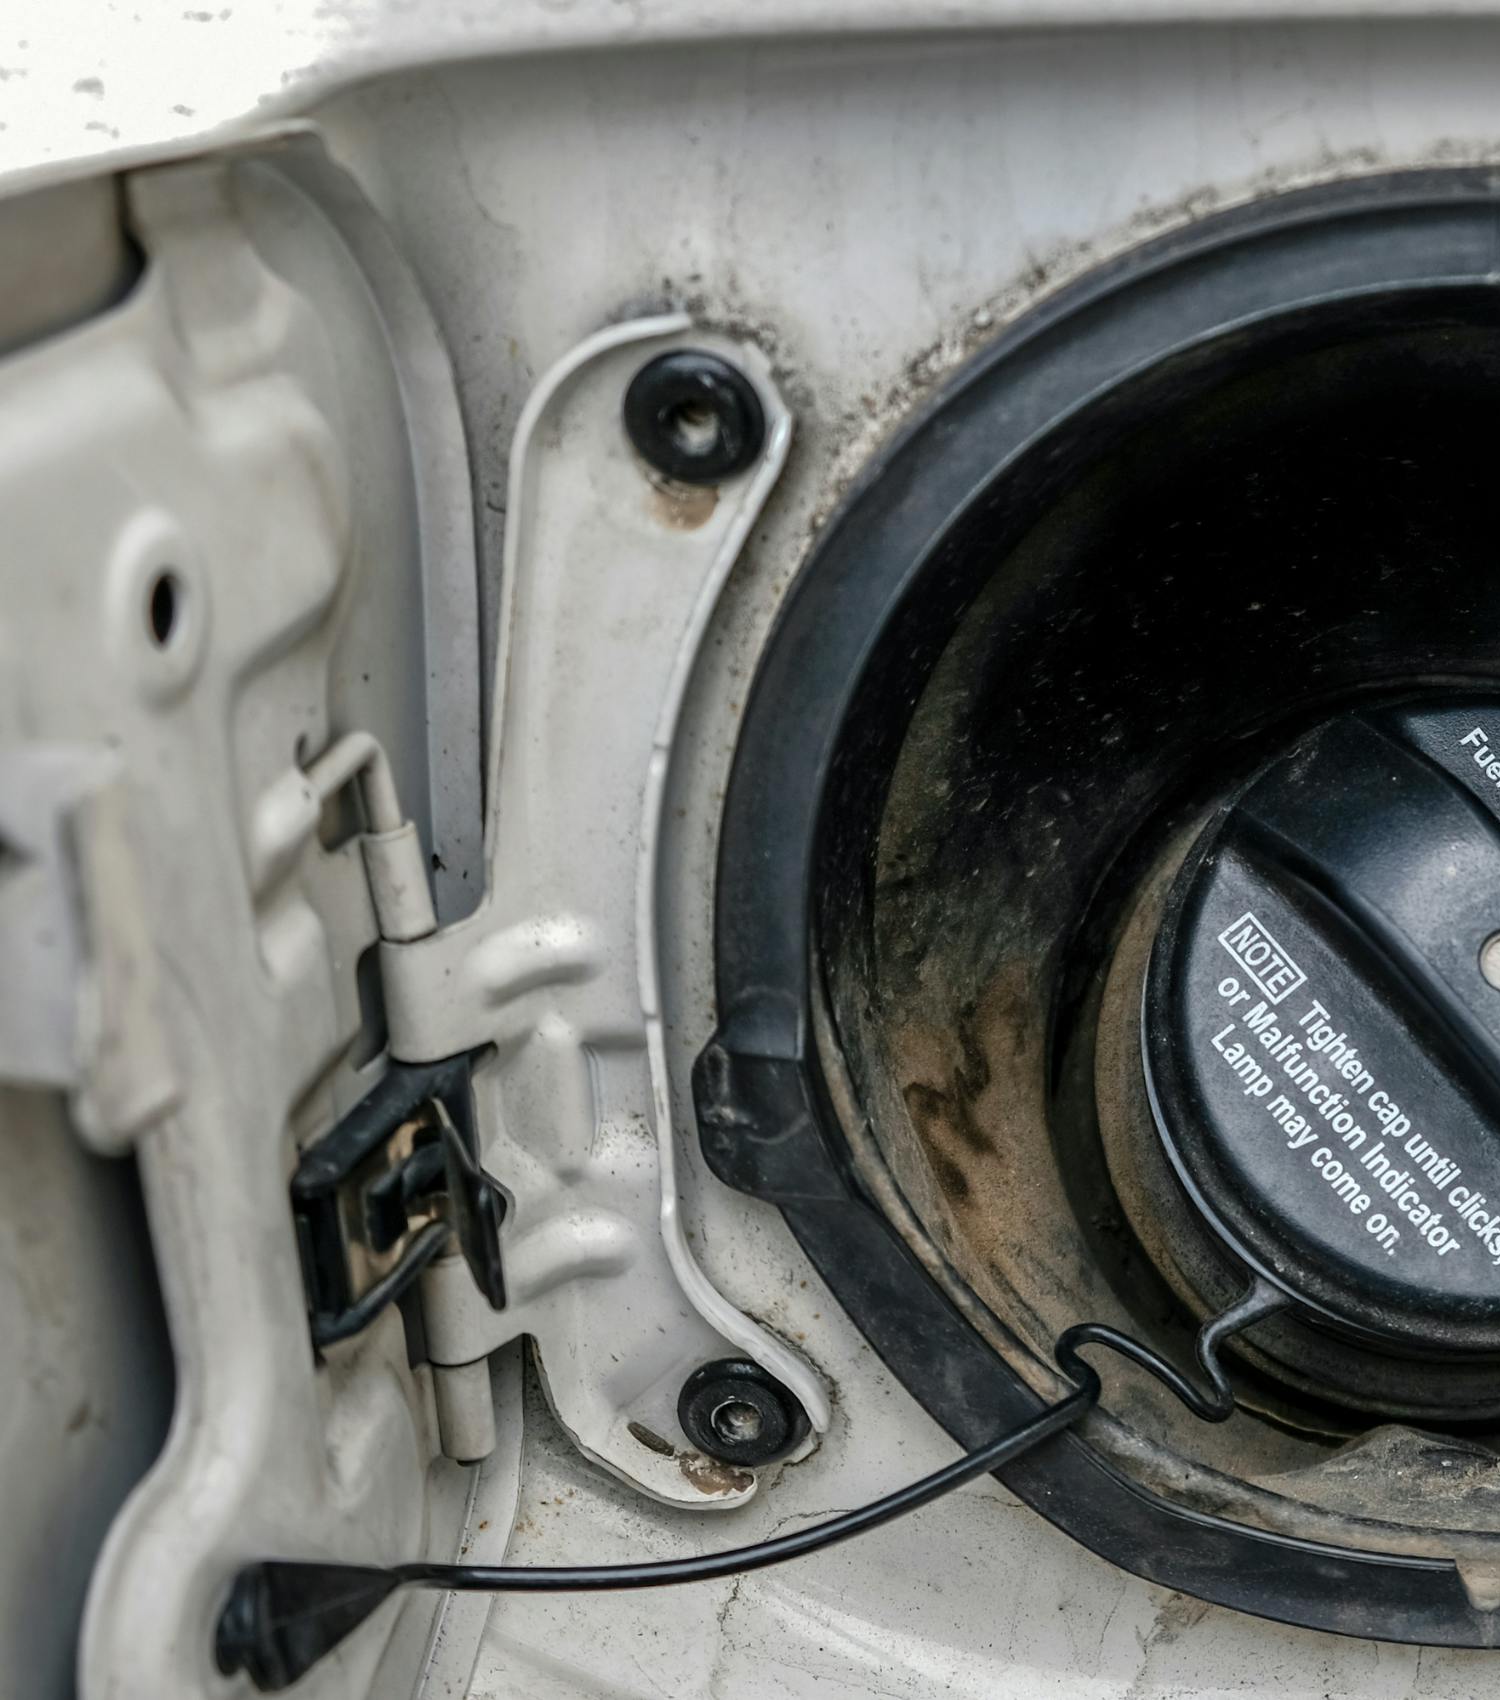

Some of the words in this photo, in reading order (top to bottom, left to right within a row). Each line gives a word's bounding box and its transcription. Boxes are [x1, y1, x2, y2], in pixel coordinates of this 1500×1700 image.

[1210, 1024, 1273, 1097] Lamp
[1267, 1095, 1319, 1149] may
[1311, 1148, 1371, 1214] come
[1365, 1214, 1400, 1256] on.
[1217, 977, 1250, 1006] or
[1242, 1001, 1367, 1151] Malfunction
[1360, 1142, 1461, 1256] Indicator
[1230, 925, 1296, 994] NOTE
[1298, 1000, 1374, 1094] Tighten
[1367, 1091, 1411, 1139] cap
[1404, 1133, 1462, 1190] until
